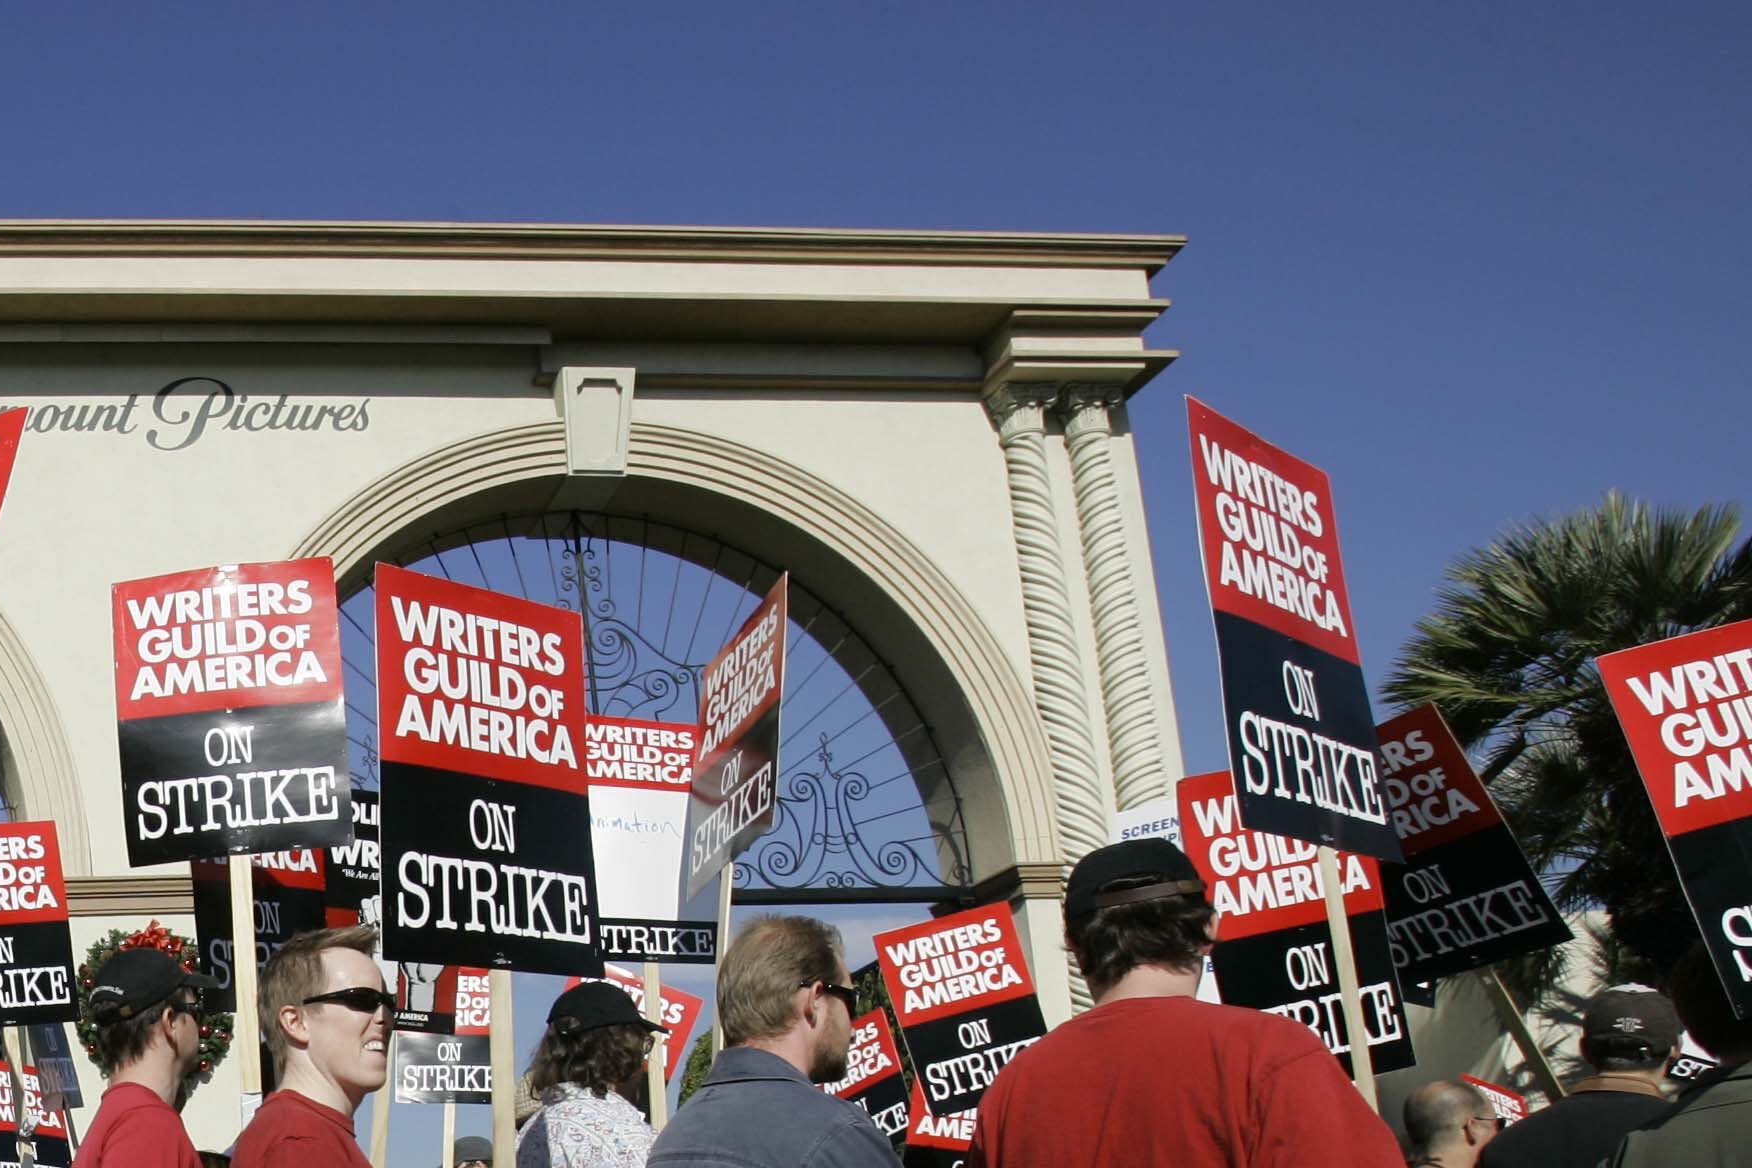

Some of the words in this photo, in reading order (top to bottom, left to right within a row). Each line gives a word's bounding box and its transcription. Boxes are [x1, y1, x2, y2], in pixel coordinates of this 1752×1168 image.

[146, 376, 371, 451] Pictures
[1199, 433, 1322, 538] WRITERS
[1215, 492, 1301, 569] GUILD
[1302, 544, 1329, 585] OF
[127, 579, 313, 630] WRITERS
[1220, 541, 1347, 638] AMERICA
[137, 619, 267, 664] GUILD
[268, 624, 311, 650] OF
[391, 596, 566, 676] WRITERS
[706, 603, 778, 699] WRITERS
[130, 650, 328, 700] AMERICA
[403, 647, 527, 711] GUILD
[528, 684, 564, 720] OF
[705, 656, 758, 726] GUILD
[757, 641, 776, 676] OF
[1282, 659, 1321, 722] ON
[1626, 647, 1752, 716] WRIT
[395, 694, 579, 770] AMERICA
[585, 723, 694, 750] WRITERS
[699, 664, 775, 762] AMERICA
[1660, 696, 1752, 758] GUI
[204, 725, 254, 767] ON
[586, 741, 662, 765] GUILD
[663, 752, 691, 767] OF
[1239, 711, 1387, 826] STRIKE
[721, 750, 743, 796] ON
[1410, 767, 1448, 799] OF
[137, 765, 339, 841] STRIKE
[469, 799, 516, 854] ON
[590, 809, 681, 839] nimation
[692, 761, 771, 876] STRIKE
[1392, 788, 1481, 839] RICA
[18, 866, 45, 885] OF
[398, 850, 591, 945] STRIKE
[1214, 855, 1371, 918] AMERIA
[1403, 864, 1451, 903] ON
[253, 901, 280, 934] ON
[885, 918, 1002, 967] WRITERS
[1387, 880, 1549, 968] STRIKE
[900, 949, 979, 988] GUILD
[980, 947, 1006, 968] OF
[904, 963, 1023, 1014] AMERICA
[1285, 942, 1330, 991] ON
[437, 1042, 462, 1061] ON
[862, 1041, 881, 1057] OF
[958, 1018, 992, 1049] ON
[823, 1052, 893, 1095] MERICA
[926, 1036, 1042, 1101] STRI
